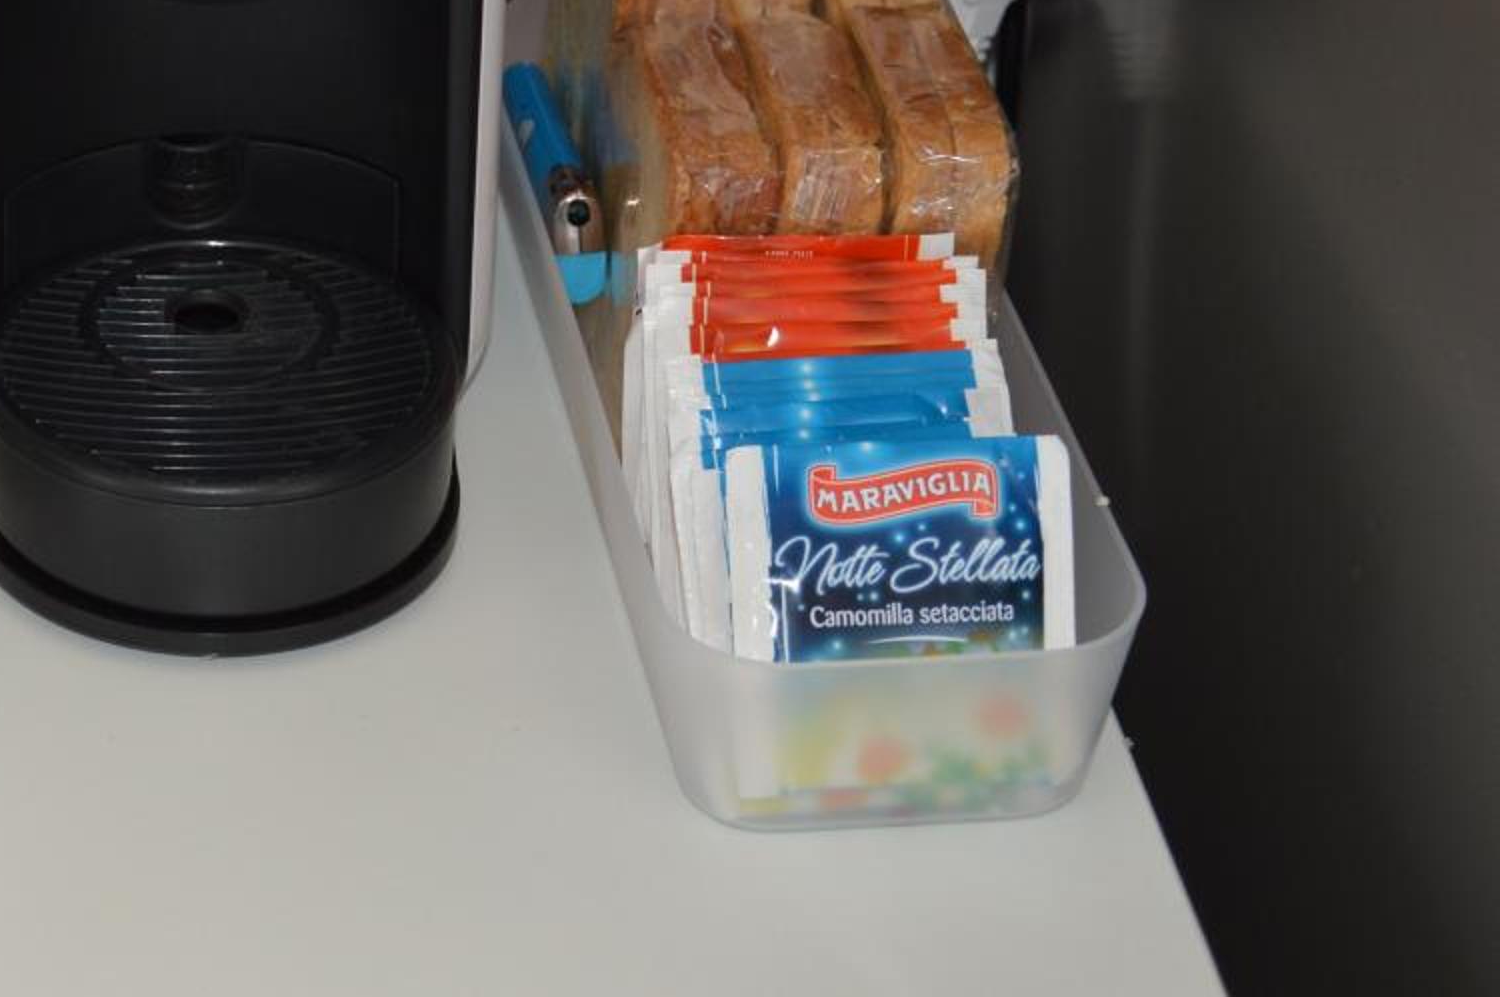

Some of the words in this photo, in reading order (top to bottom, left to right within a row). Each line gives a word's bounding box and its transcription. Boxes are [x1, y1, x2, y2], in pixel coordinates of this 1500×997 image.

[818, 471, 991, 512] MARAVIGLIA
[774, 535, 890, 596] Notte
[890, 537, 1042, 593] Stellata
[809, 602, 914, 629] Camomilla
[919, 600, 1015, 624] setacciata
